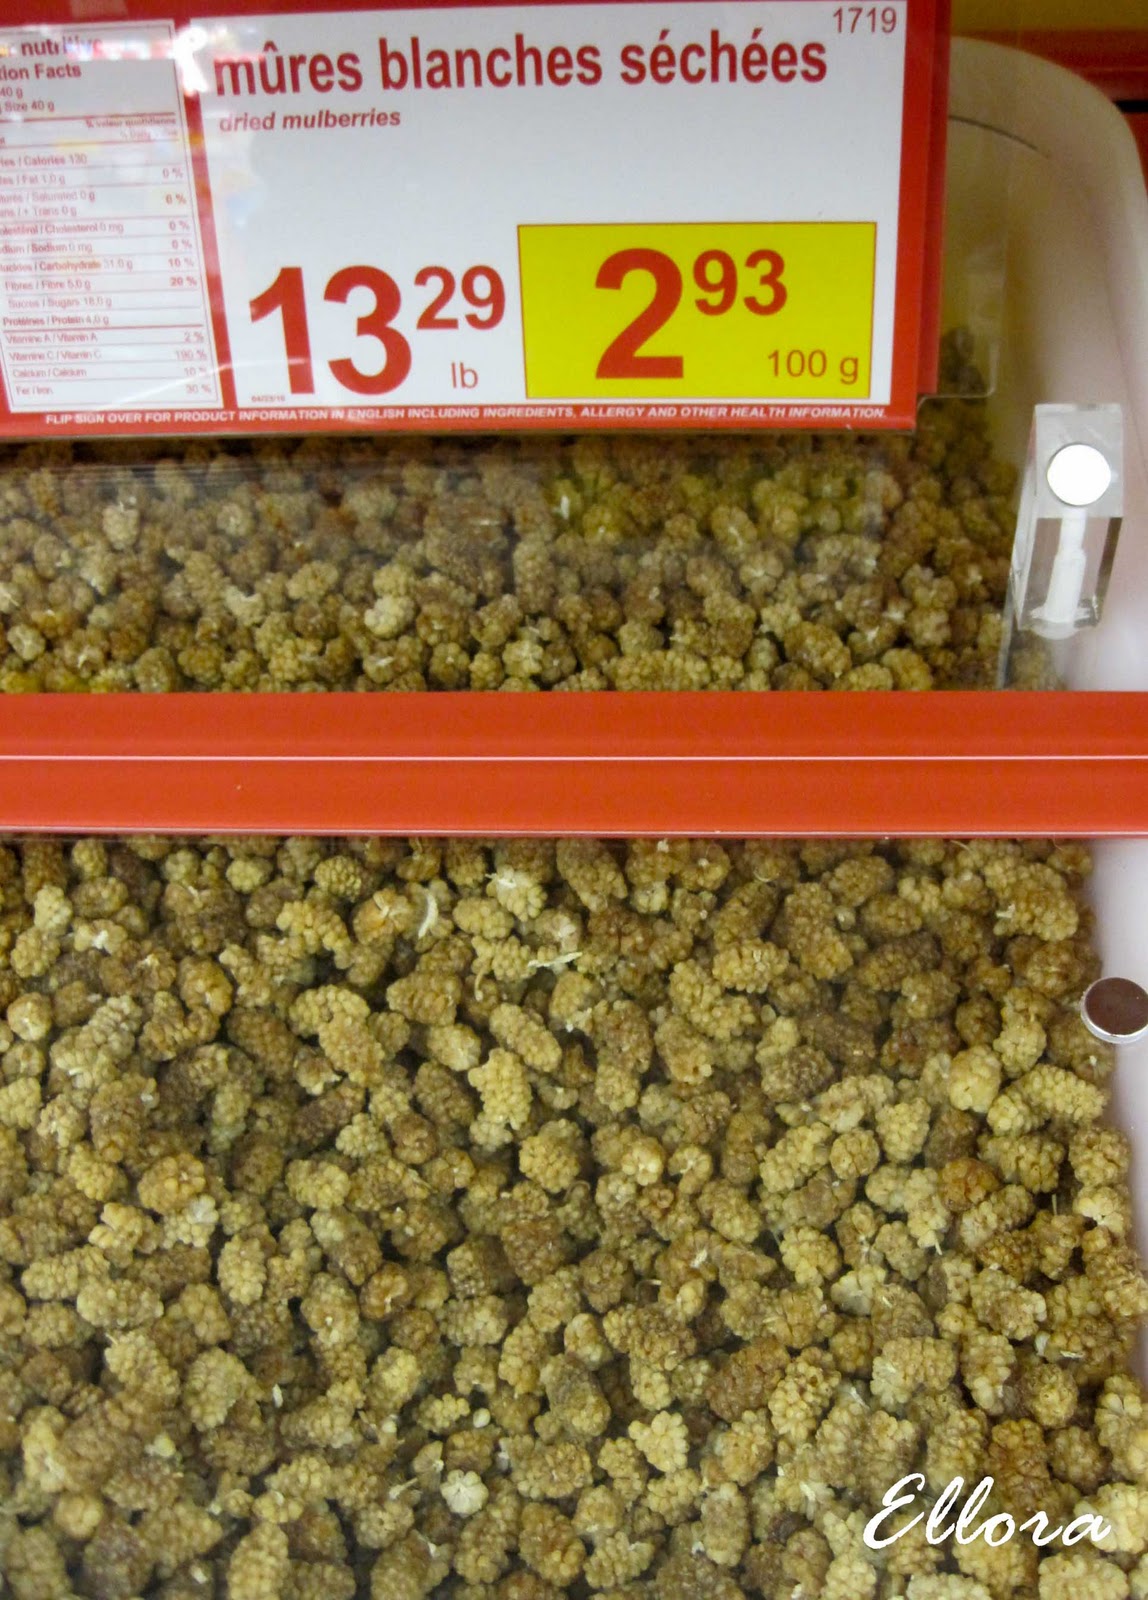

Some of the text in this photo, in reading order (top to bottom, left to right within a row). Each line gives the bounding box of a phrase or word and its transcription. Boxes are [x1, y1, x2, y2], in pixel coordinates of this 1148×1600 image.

[832, 7, 896, 34] 1719
[21, 36, 105, 57] nutrie
[34, 63, 82, 80] Facts
[213, 28, 827, 97] mûres blanches séchées
[219, 107, 402, 131] dried mulberries
[595, 248, 788, 379] 2 93
[249, 265, 506, 396] 13 29
[450, 361, 479, 390] lb
[768, 348, 860, 385] 100 g
[46, 413, 72, 424] FLIP
[74, 411, 104, 424] SIGN
[106, 411, 142, 423] OVER
[144, 411, 171, 423] FOR
[173, 410, 235, 422] PRODUCT
[238, 410, 328, 421] INFORMATION
[330, 409, 344, 420] IN
[347, 408, 405, 420] ENGLISH
[407, 407, 479, 419] INCLUDING
[482, 407, 578, 419] INGREDIENTS,
[580, 406, 645, 417] ALLERGY
[647, 406, 678, 417] AND
[680, 406, 728, 417] OTHER
[730, 406, 786, 417] HEALTH
